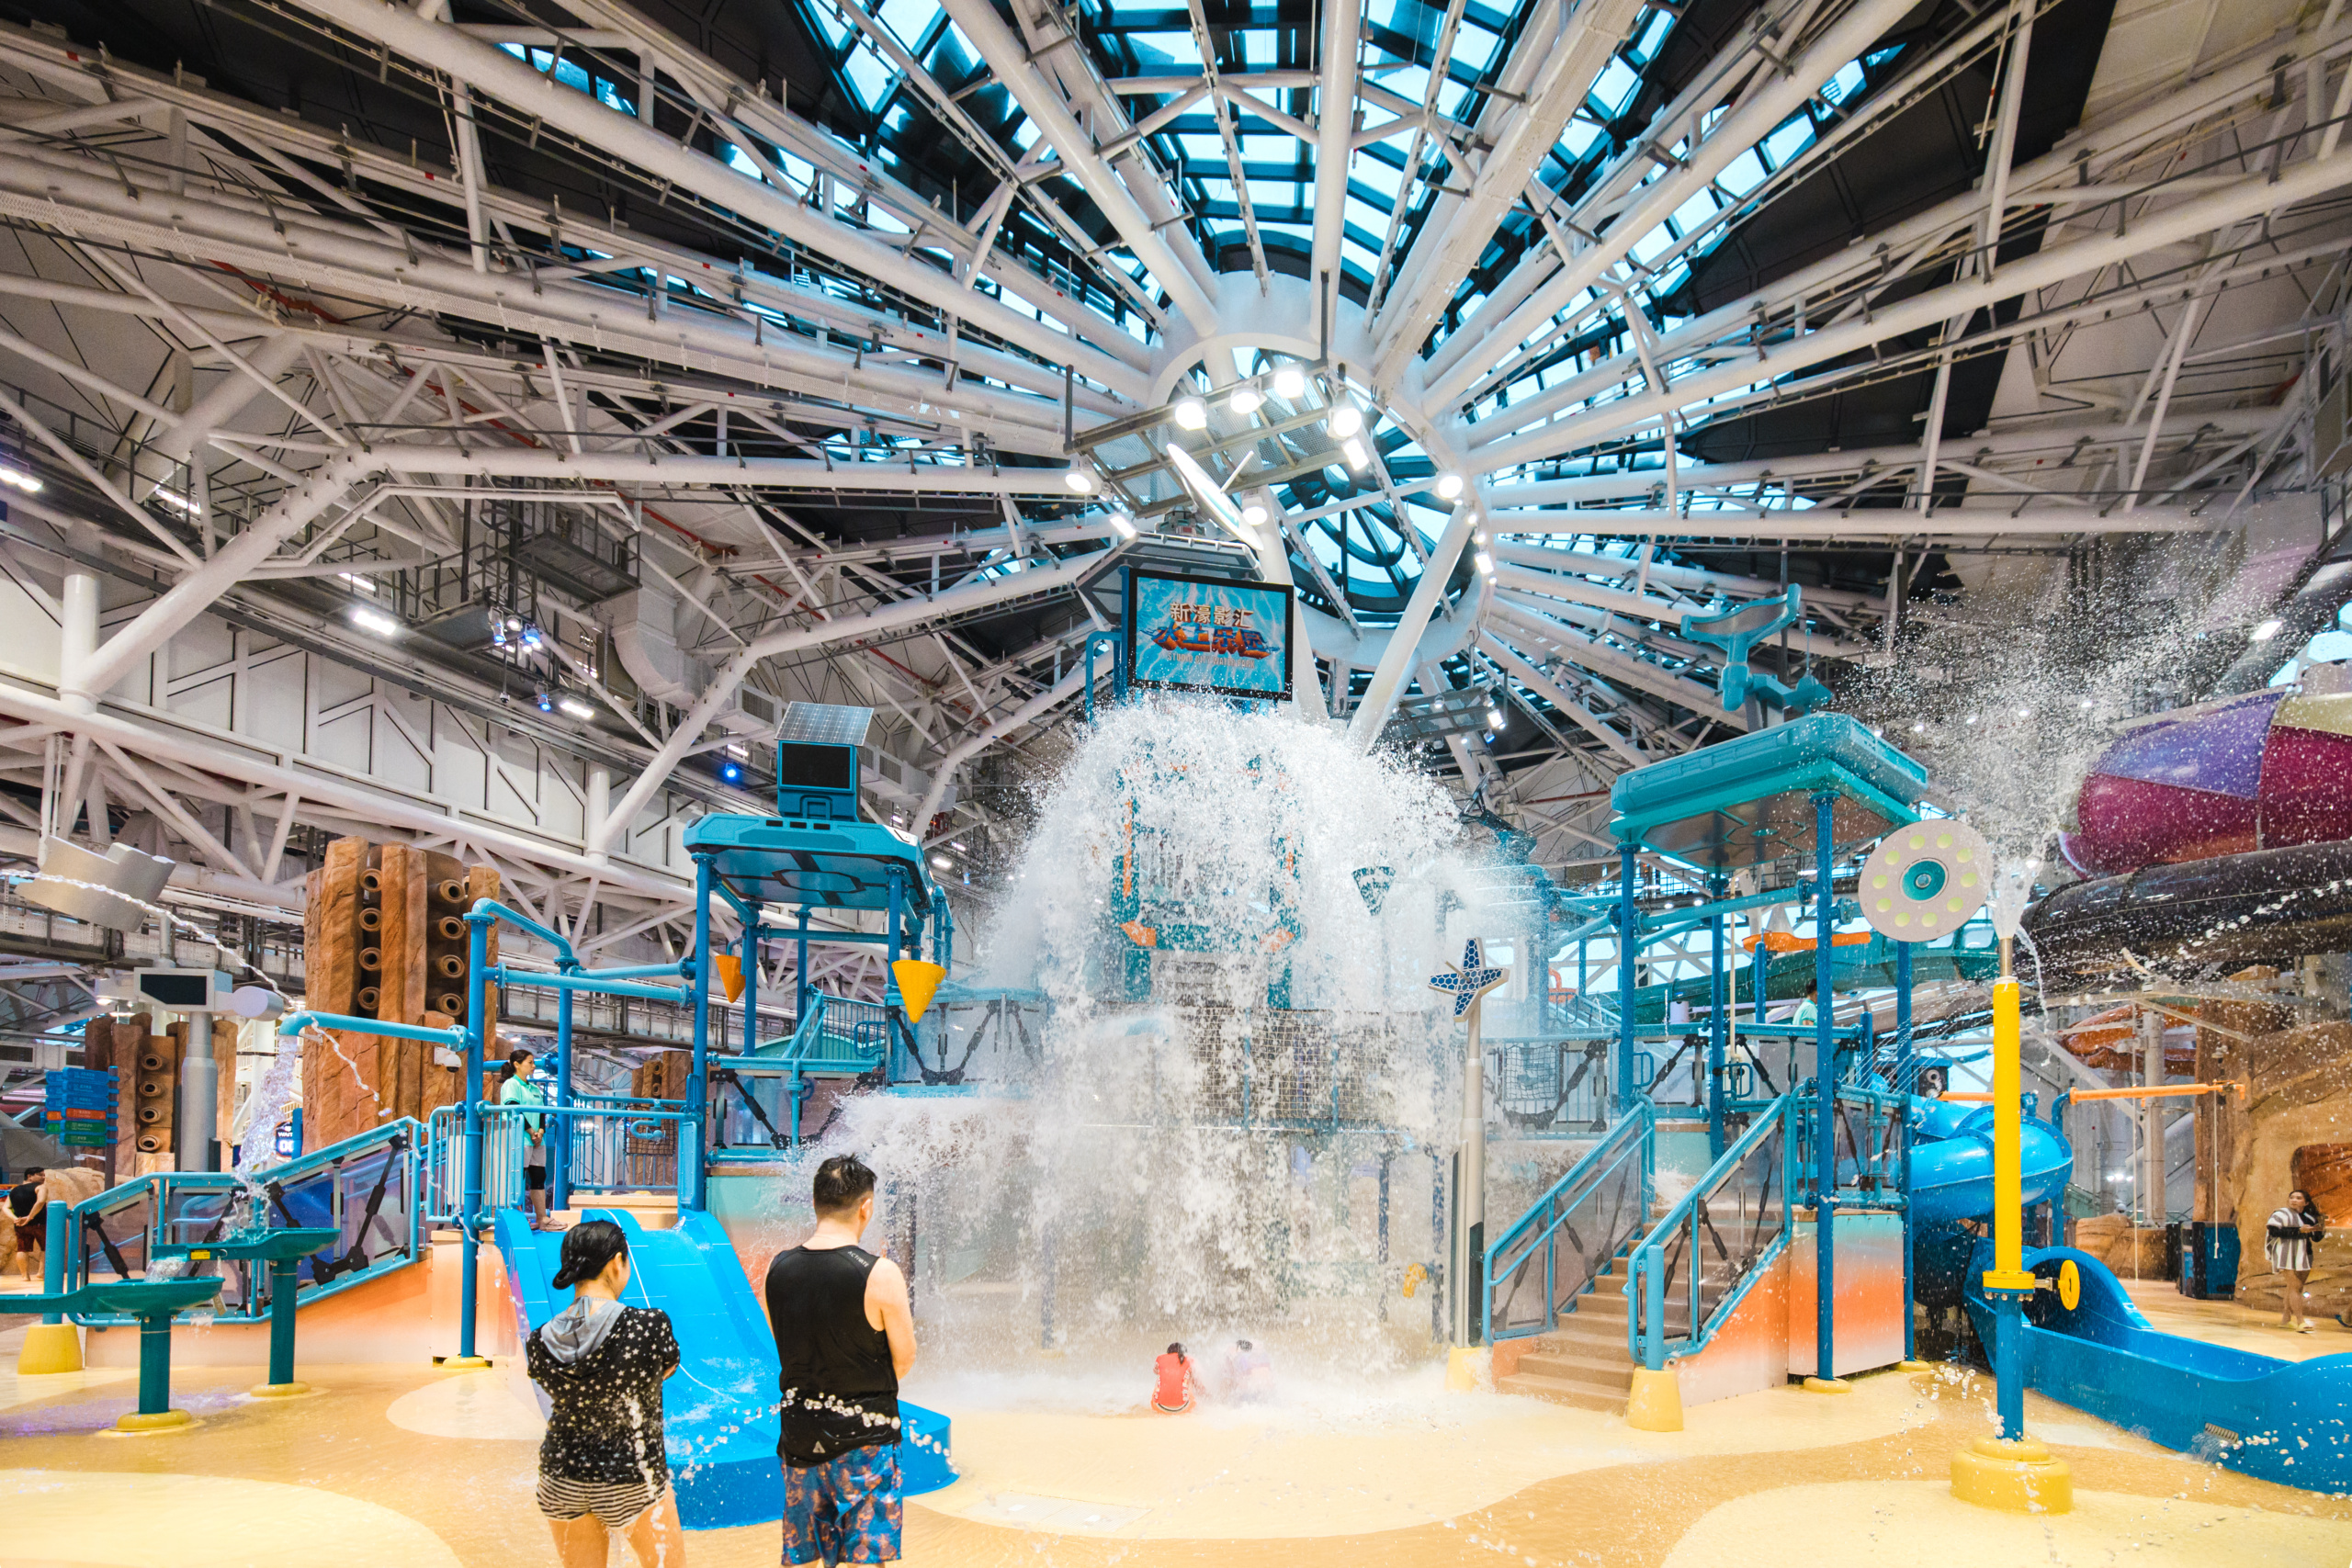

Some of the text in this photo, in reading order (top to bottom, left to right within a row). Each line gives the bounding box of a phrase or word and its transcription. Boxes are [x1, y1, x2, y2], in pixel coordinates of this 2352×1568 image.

[1170, 602, 1255, 628] 新濠影汇
[1151, 621, 1271, 659] 水上乐园
[1167, 652, 1255, 669] STUDIO CITY WATER PARK
